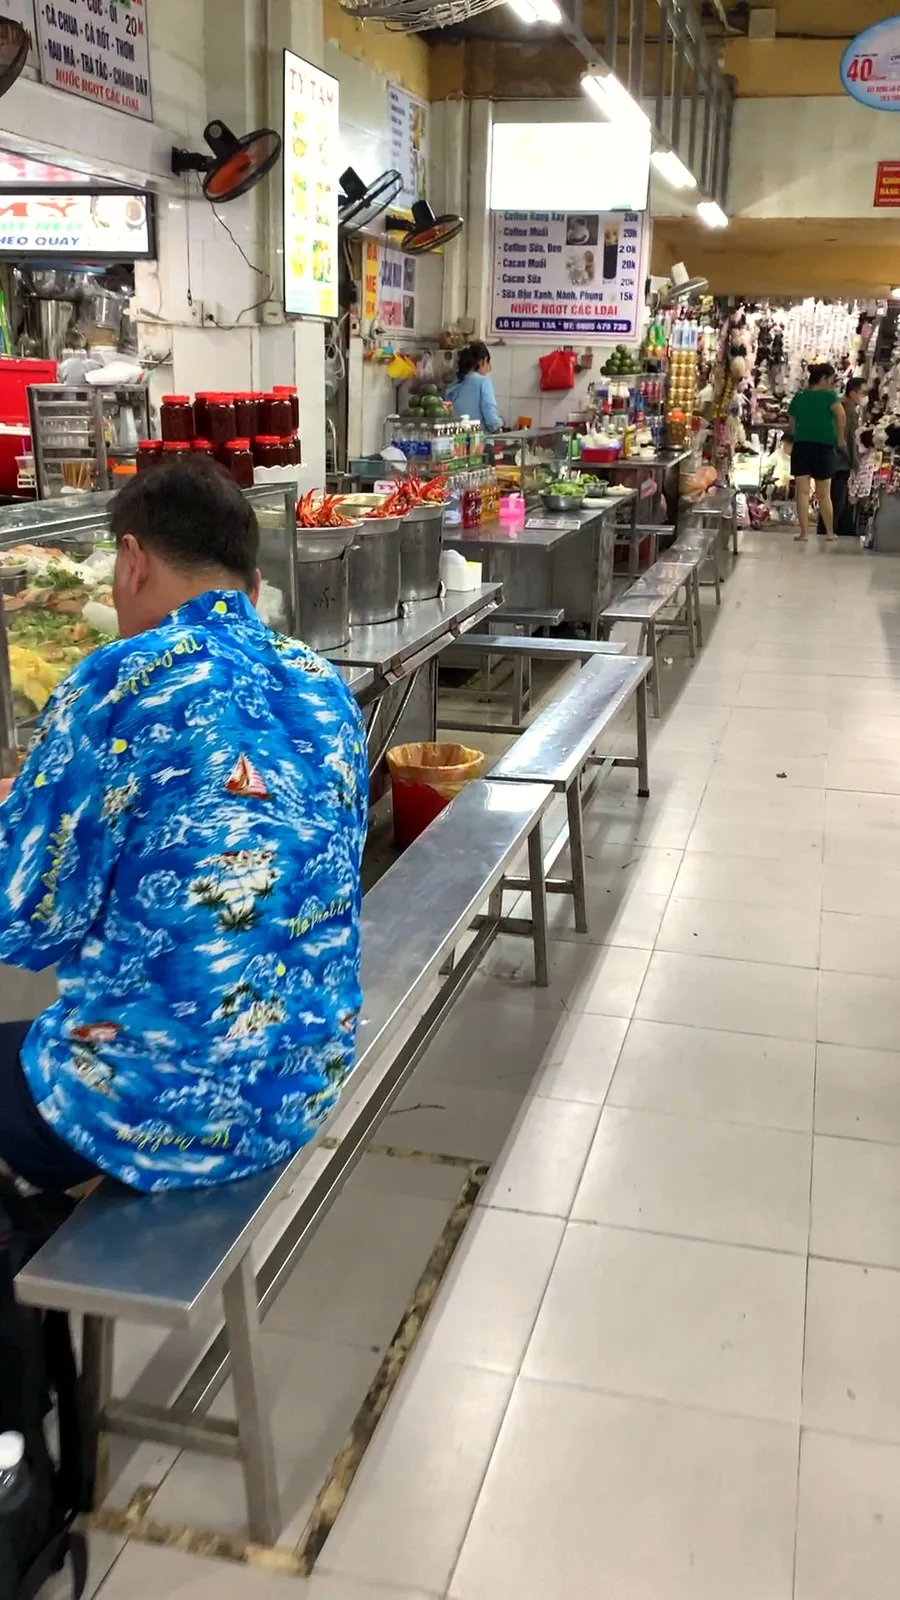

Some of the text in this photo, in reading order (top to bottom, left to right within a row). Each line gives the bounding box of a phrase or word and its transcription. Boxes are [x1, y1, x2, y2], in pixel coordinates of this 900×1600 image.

[847, 58, 873, 81] 40
[35, 236, 80, 246] QUAY
[503, 258, 526, 268] Cacao
[621, 260, 636, 269] 20k
[502, 273, 525, 284] Cacao
[620, 292, 634, 301] 15k
[571, 302, 592, 315] CÁC
